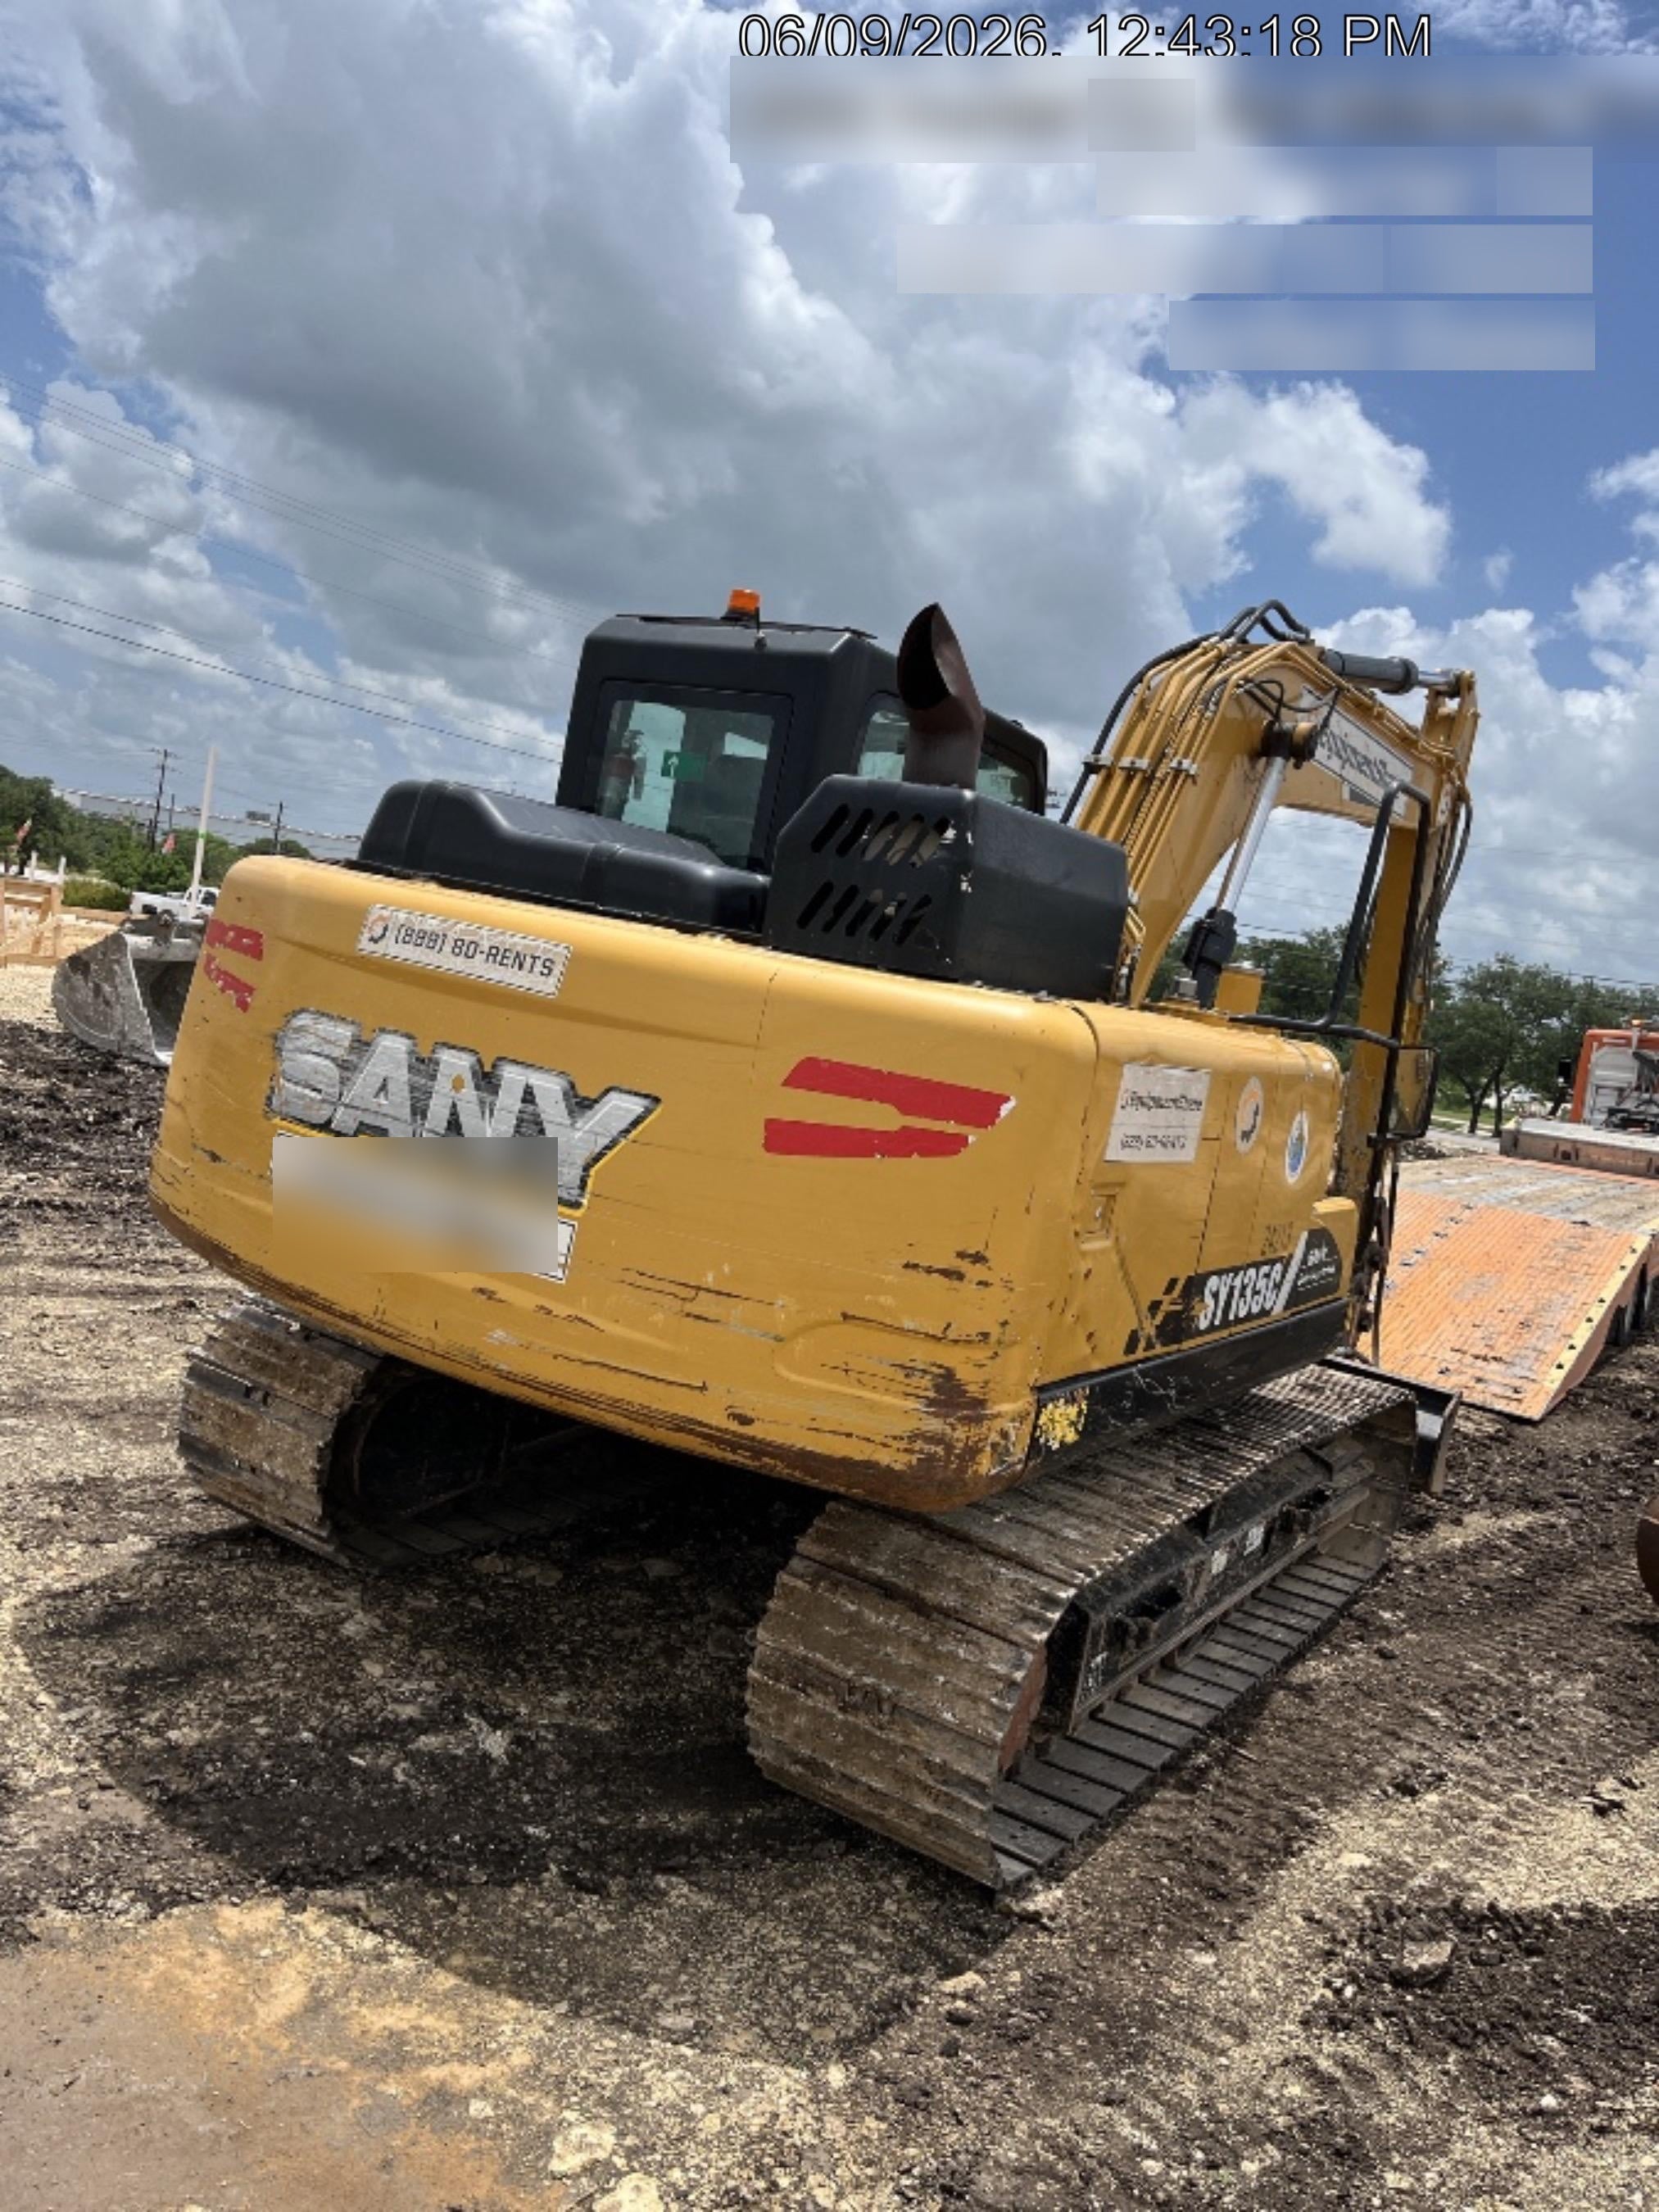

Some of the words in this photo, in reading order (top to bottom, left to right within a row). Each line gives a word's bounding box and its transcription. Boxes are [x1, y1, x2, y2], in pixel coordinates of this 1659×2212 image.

[394, 923, 447, 953] (888)
[451, 938, 557, 978] 80-RENTS
[269, 1009, 660, 1208] SANY
[1199, 1262, 1284, 1330] SY135C
